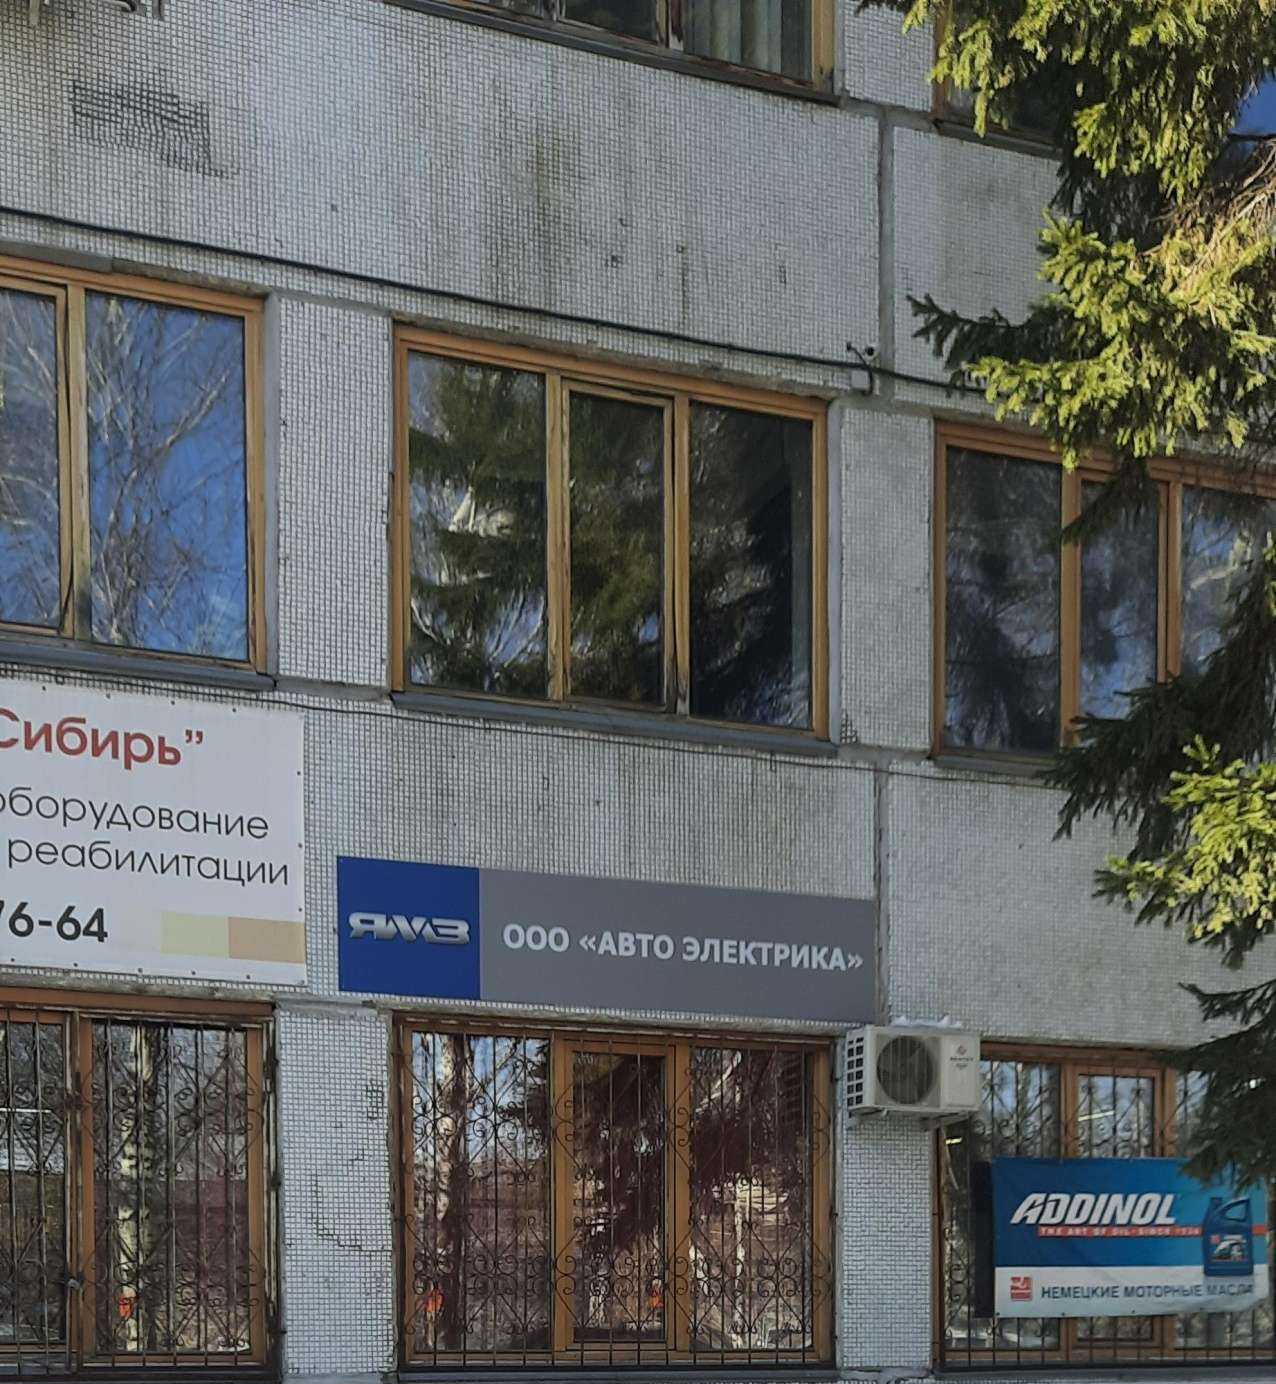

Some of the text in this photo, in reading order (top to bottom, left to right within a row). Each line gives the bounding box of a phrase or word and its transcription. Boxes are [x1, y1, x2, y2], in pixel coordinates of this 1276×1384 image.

[0, 787, 269, 839] борудование
[8, 839, 289, 886] реабилитации
[0, 901, 108, 943] 6-64
[502, 923, 864, 972] ООО «АВТО ЭЛЕКТРИКА»
[1010, 1192, 1177, 1226] ADDINOL
[1041, 1285, 1120, 1299] НЕМЕЦКИЕ
[1123, 1284, 1203, 1298] МОТОРНЫЕ
